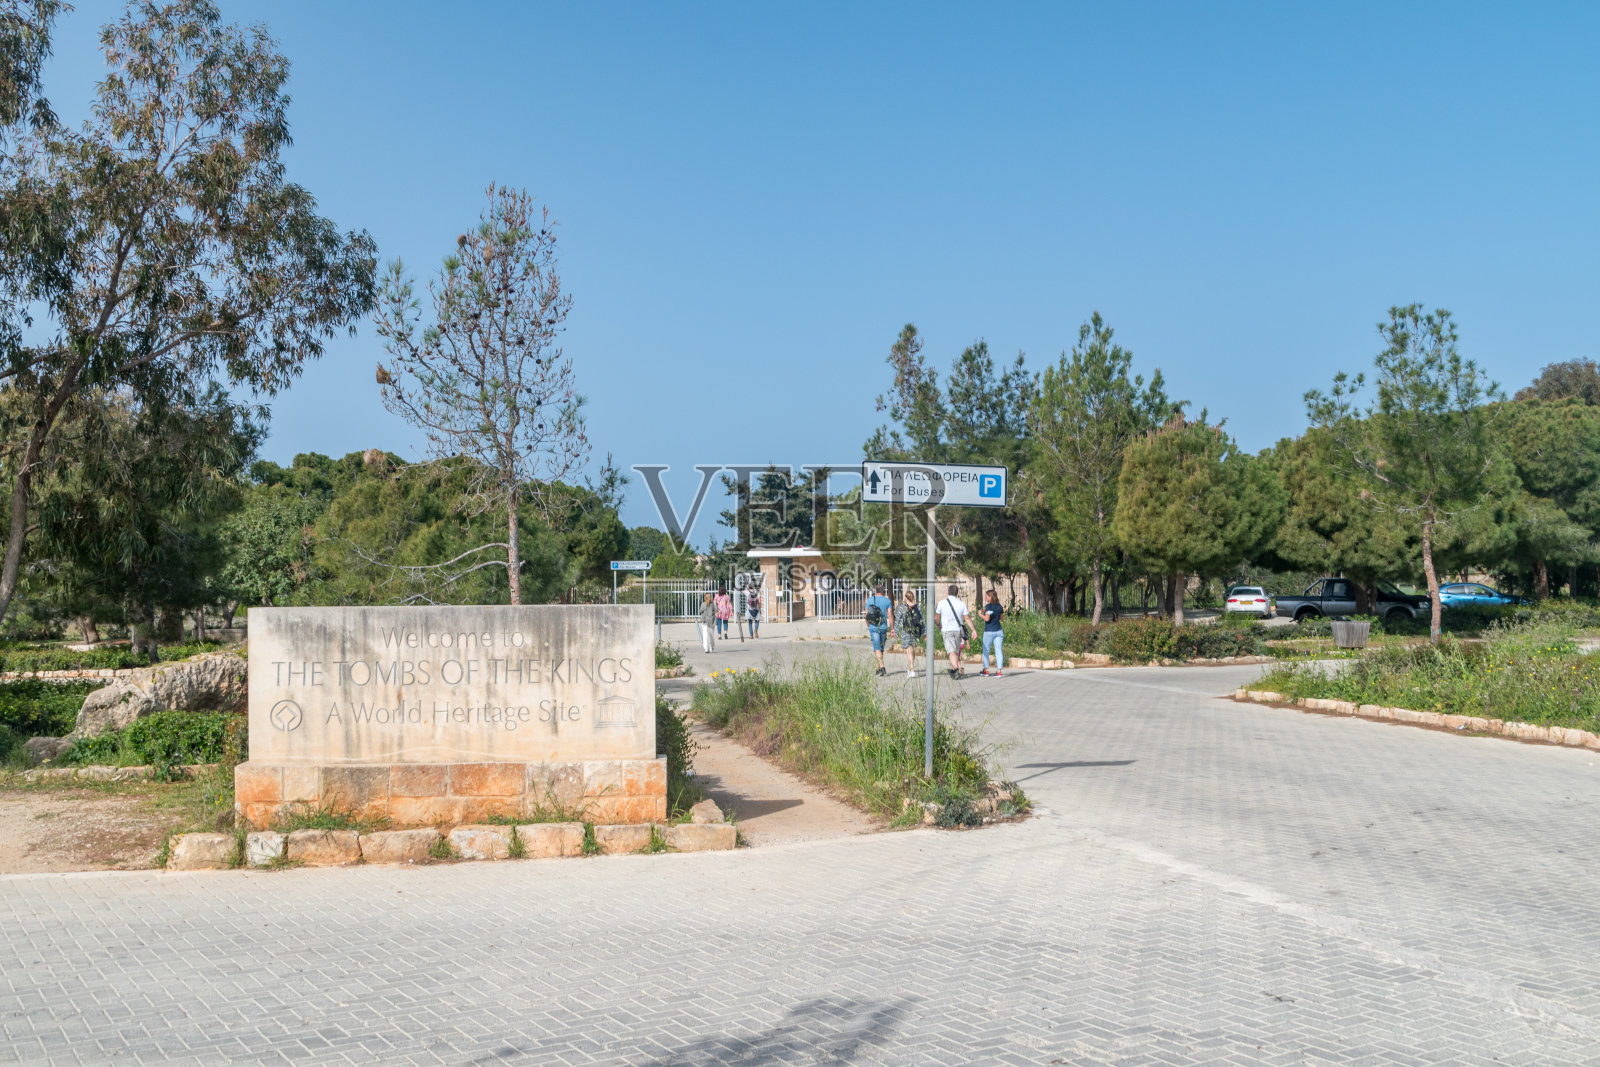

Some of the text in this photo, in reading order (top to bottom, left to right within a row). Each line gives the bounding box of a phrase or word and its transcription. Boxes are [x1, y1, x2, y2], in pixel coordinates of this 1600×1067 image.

[905, 470, 979, 483] ΛΕΩΦΟΡΕΙΑ
[984, 477, 997, 495] P
[883, 484, 945, 497] For Buses
[382, 627, 525, 649] Welcome to
[272, 657, 633, 687] THE TOMBS OF THE KINGS
[325, 698, 582, 731] A World Heritage Site
